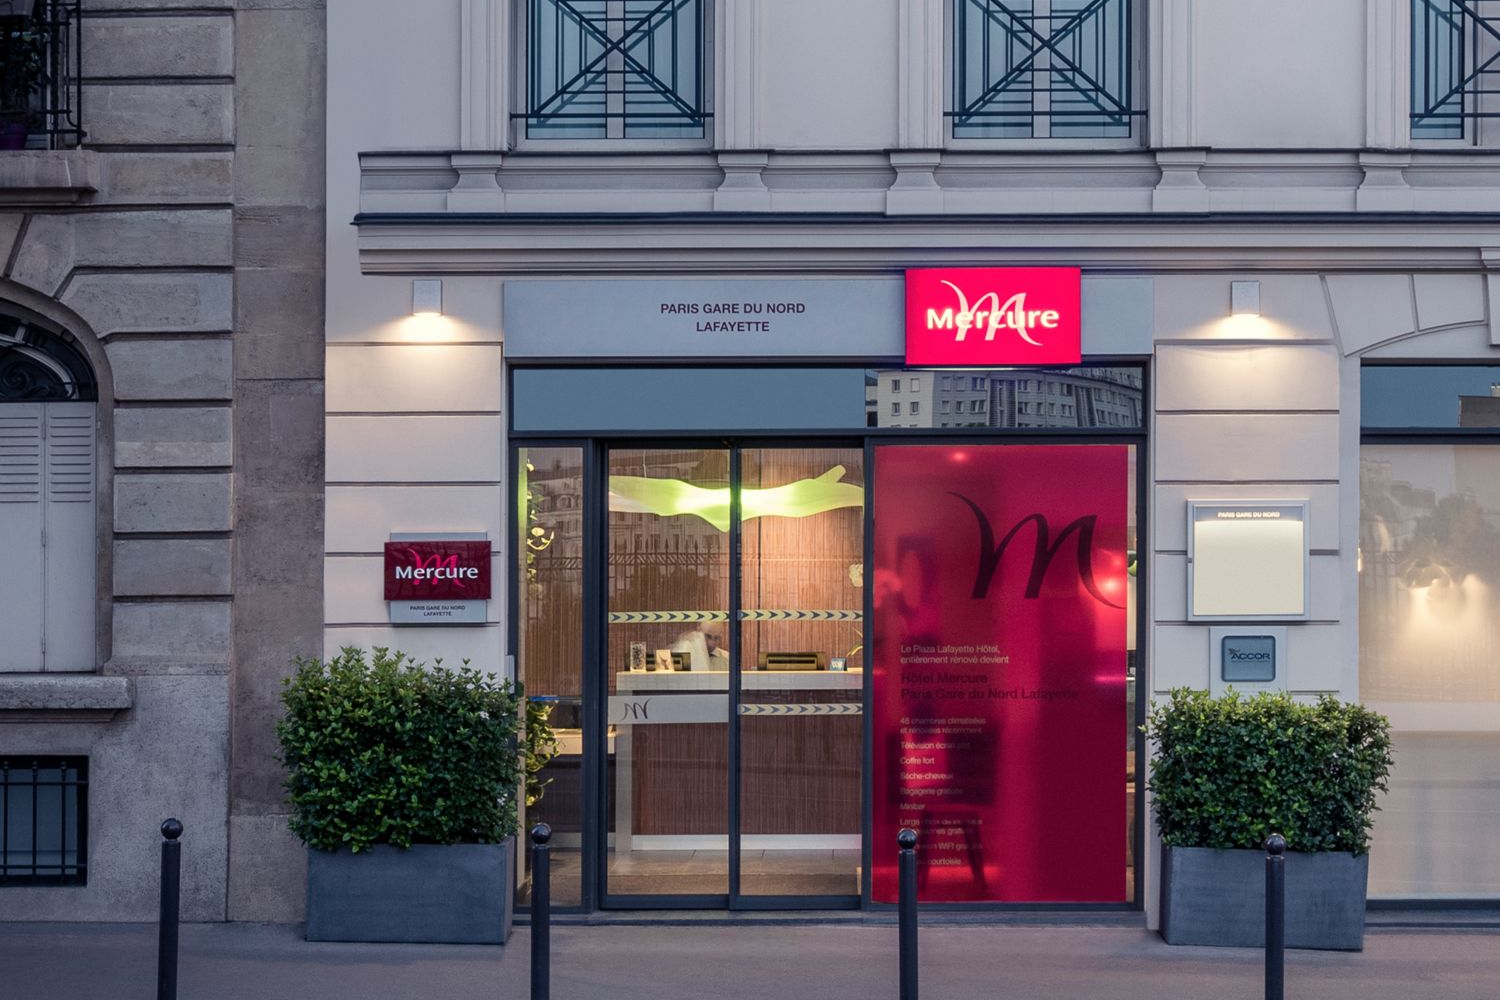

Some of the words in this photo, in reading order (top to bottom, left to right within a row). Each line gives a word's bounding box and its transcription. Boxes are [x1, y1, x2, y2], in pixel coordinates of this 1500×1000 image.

[660, 303, 699, 314] PARIS
[702, 303, 740, 314] GARE
[743, 303, 763, 314] DU
[766, 303, 806, 314] NORD
[926, 307, 1060, 330] Mercure
[696, 321, 770, 332] LAFAYETTE
[395, 566, 479, 579] Mercure
[900, 644, 911, 654] Le
[937, 644, 975, 656] Lafayette
[979, 655, 1009, 664] devient
[1231, 652, 1271, 660] ACCOR
[936, 673, 989, 684] Mercure
[901, 688, 932, 699] Paris
[935, 688, 965, 699] Gare
[968, 688, 985, 699] du
[988, 688, 1018, 699] Nord
[1021, 687, 1078, 702] Lafayette
